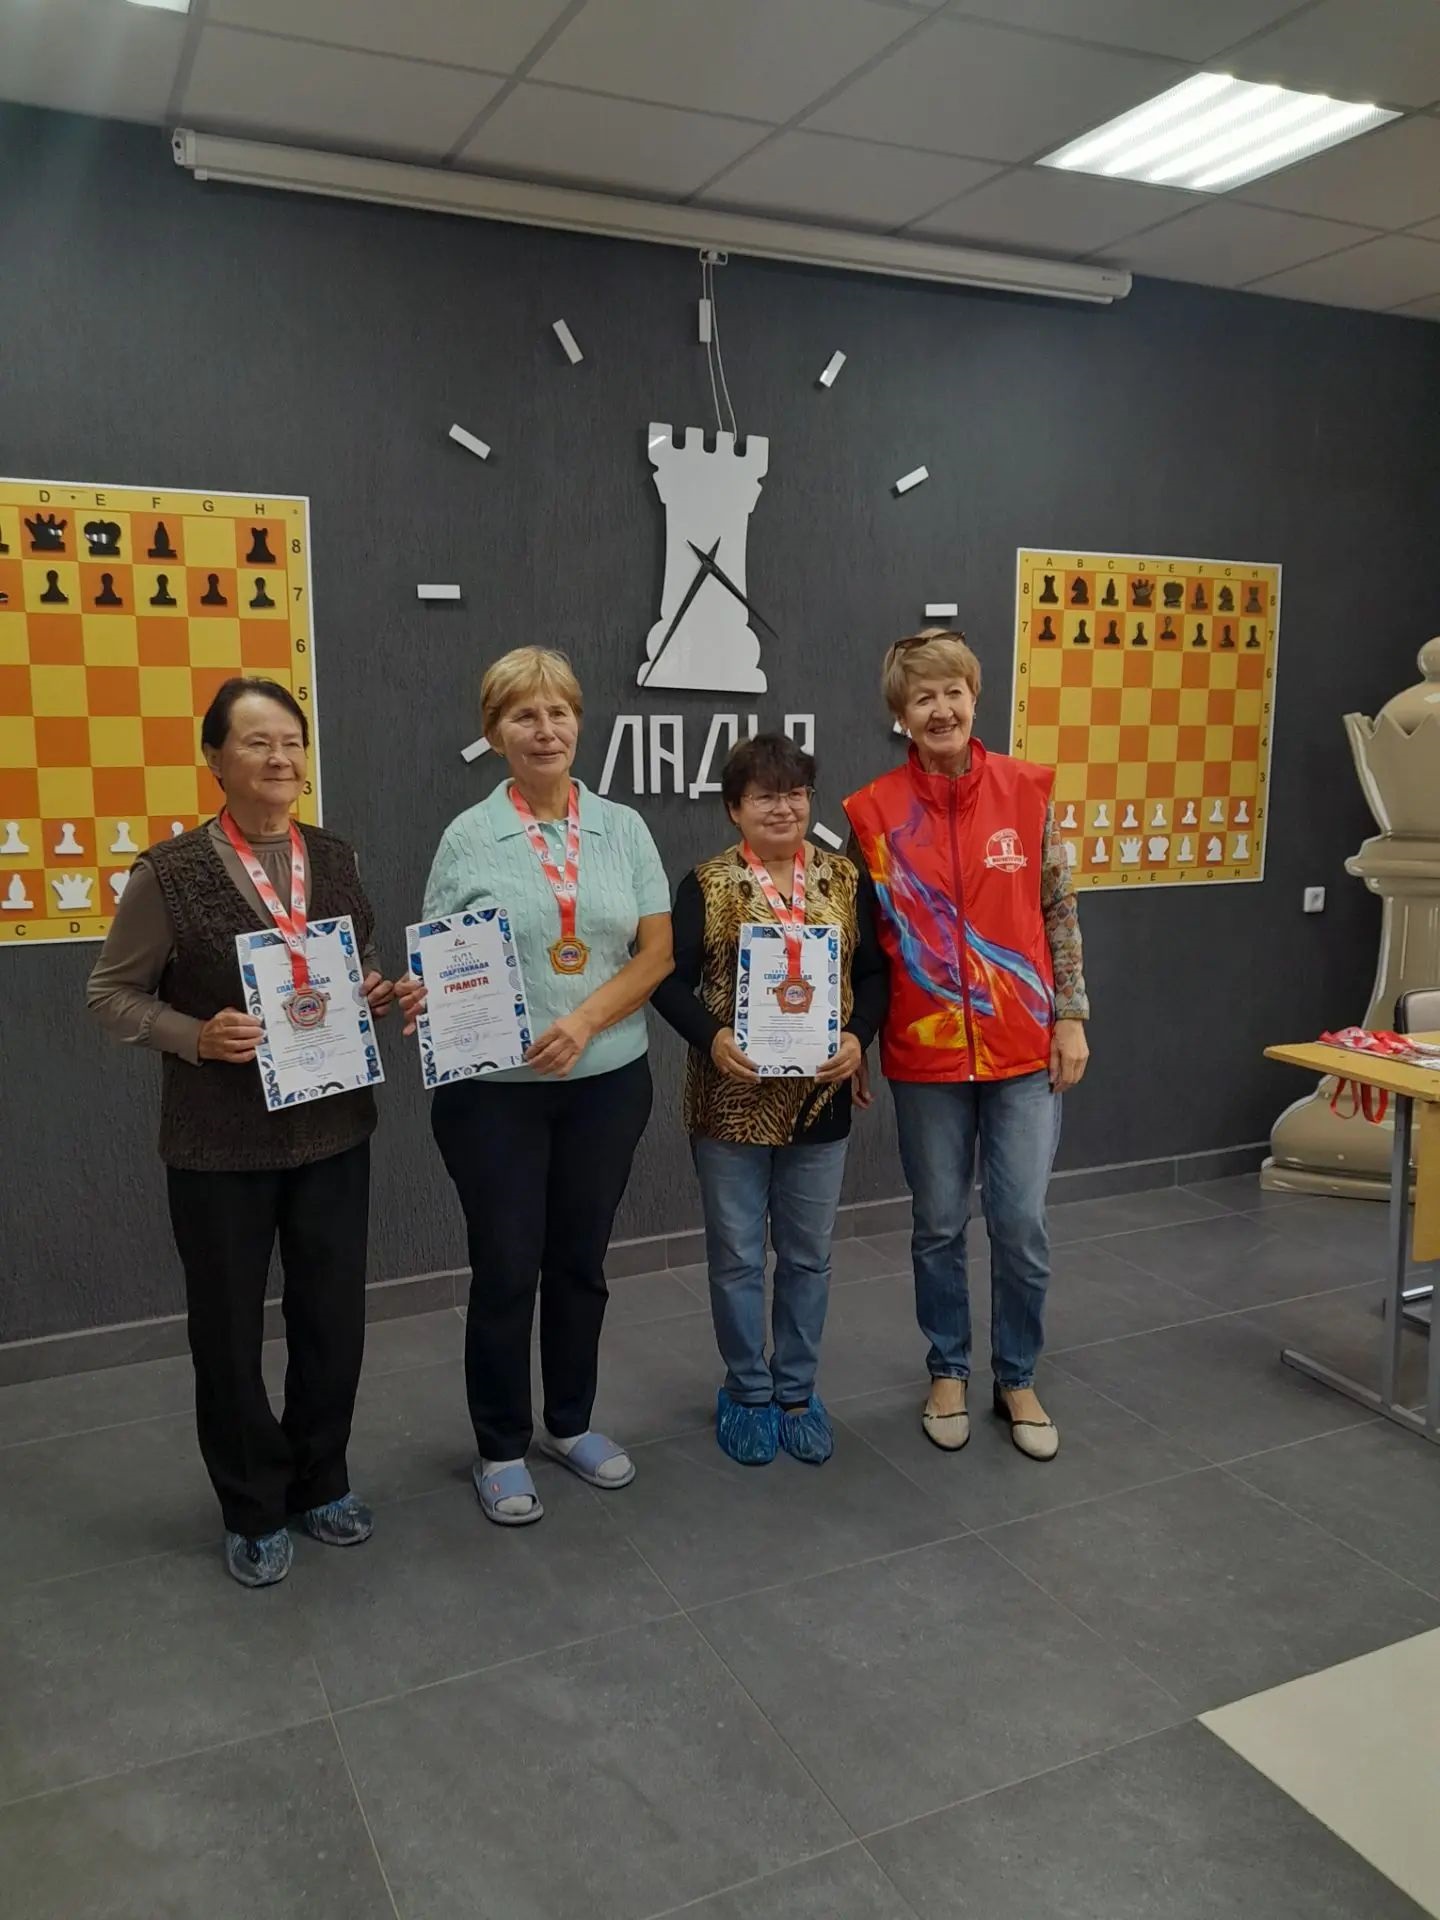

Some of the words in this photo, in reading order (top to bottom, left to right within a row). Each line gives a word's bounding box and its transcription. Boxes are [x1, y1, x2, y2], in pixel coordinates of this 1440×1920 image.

[40, 490, 50, 502] D
[96, 494, 105, 505] E
[152, 497, 160, 508] F
[203, 500, 214, 512] G
[255, 504, 264, 514] H
[292, 539, 300, 553] 8
[1047, 558, 1052, 566] A
[1077, 559, 1083, 568] B
[1108, 560, 1114, 569] C
[1139, 562, 1145, 571] D
[1169, 564, 1174, 572] E
[1198, 565, 1204, 574] F
[1225, 568, 1231, 576] G
[294, 587, 302, 601] 7
[1023, 583, 1029, 594] 8
[1022, 621, 1028, 632] 7
[1269, 630, 1274, 640] 7
[296, 639, 305, 653] 6
[1020, 663, 1026, 673] 6
[1266, 668, 1272, 678] 6
[299, 687, 307, 700] 5
[1019, 701, 1025, 712] 5
[1264, 703, 1269, 713] 5
[1016, 739, 1022, 749] 4
[1262, 738, 1267, 747] 4
[1260, 772, 1265, 782] 3
[303, 781, 312, 795] 3
[1258, 808, 1263, 818] 2
[1256, 841, 1260, 851] 1
[1092, 876, 1098, 884] C
[1122, 874, 1128, 882] D
[1151, 873, 1156, 881] E
[1180, 871, 1185, 880] F
[1207, 870, 1213, 878] G
[1234, 868, 1240, 877] H
[15, 925, 26, 936] C
[70, 922, 80, 933] D
[444, 976, 490, 994] ГРАМОТА
